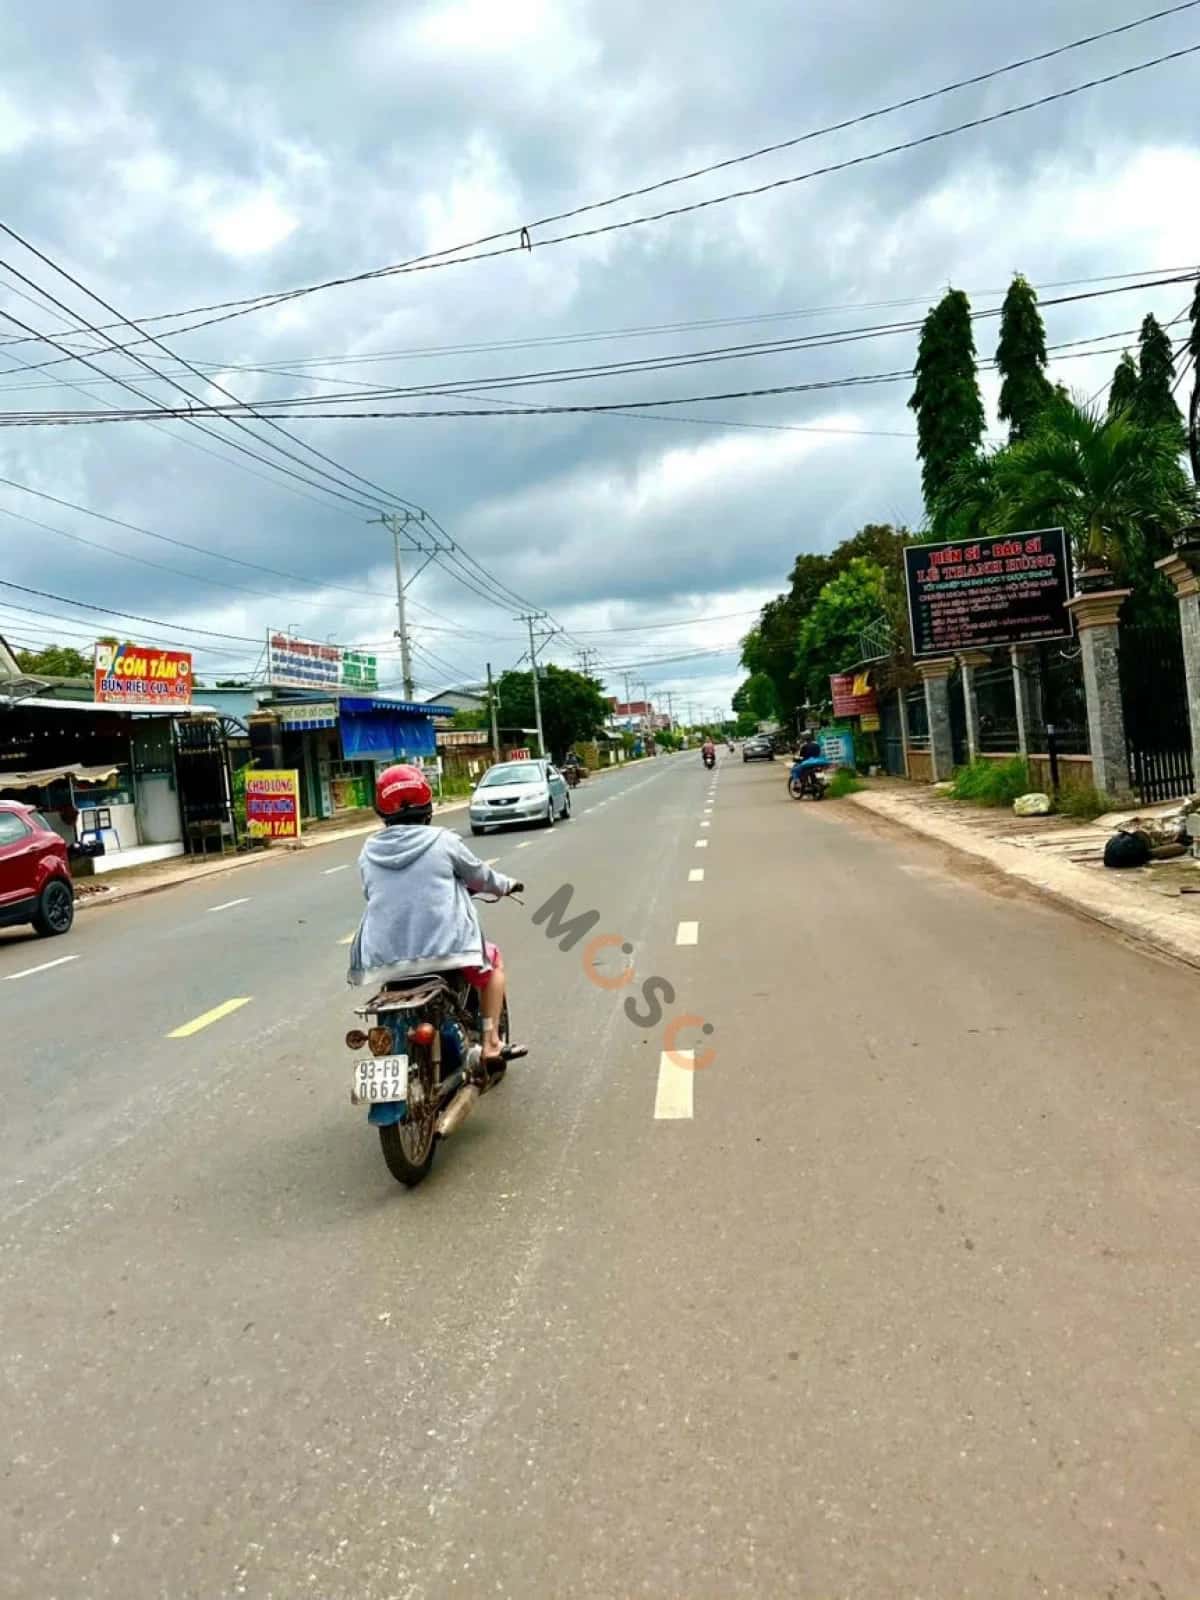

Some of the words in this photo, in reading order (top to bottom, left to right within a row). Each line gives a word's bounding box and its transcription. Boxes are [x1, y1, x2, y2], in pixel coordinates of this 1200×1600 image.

[114, 655, 147, 677] CƠM
[150, 653, 178, 679] TẤM
[101, 676, 122, 692] BÚN
[360, 1080, 400, 1099] 0662
